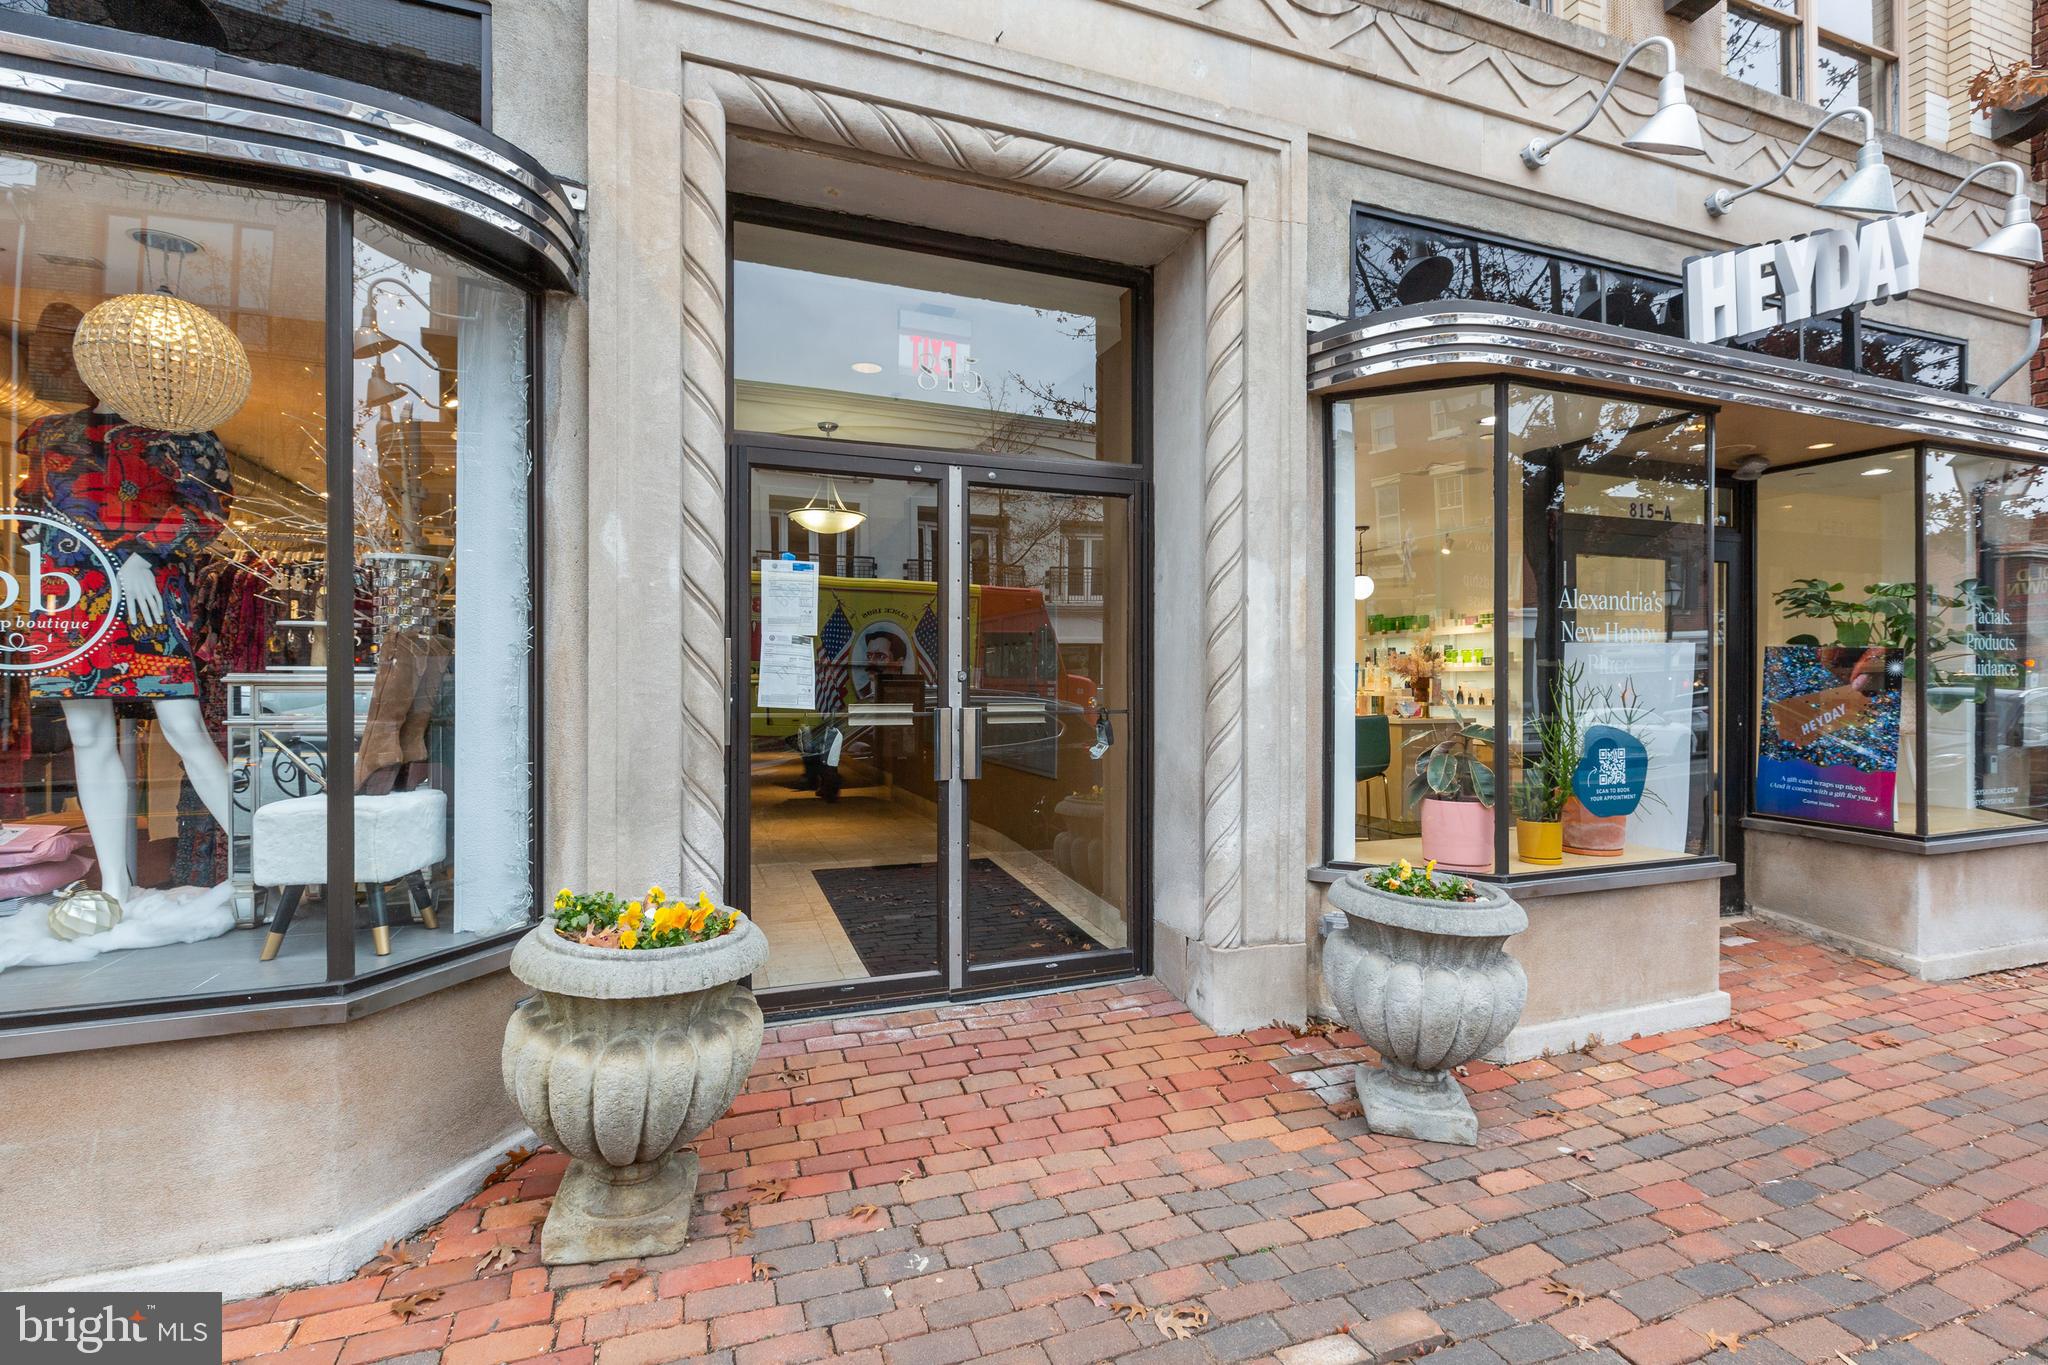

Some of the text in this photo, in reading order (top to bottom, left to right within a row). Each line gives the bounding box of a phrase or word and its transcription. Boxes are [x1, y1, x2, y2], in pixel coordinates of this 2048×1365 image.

[1684, 211, 1927, 344] HEYDAY
[917, 353, 983, 394] 815
[1629, 503, 1672, 521] 815-A
[1558, 587, 1663, 612] Alexandria's
[16, 615, 90, 634] boutique
[1972, 607, 2013, 625] Facials.
[1560, 620, 1662, 648] New Happy
[1966, 633, 2017, 651] Products.
[1802, 703, 1846, 735] HEYDAY
[1791, 785, 1812, 794] comes
[1813, 788, 1828, 796] with
[1847, 792, 1858, 800] for
[1798, 777, 1813, 785] card
[1813, 779, 1835, 789] wraps
[1835, 782, 1845, 790] up
